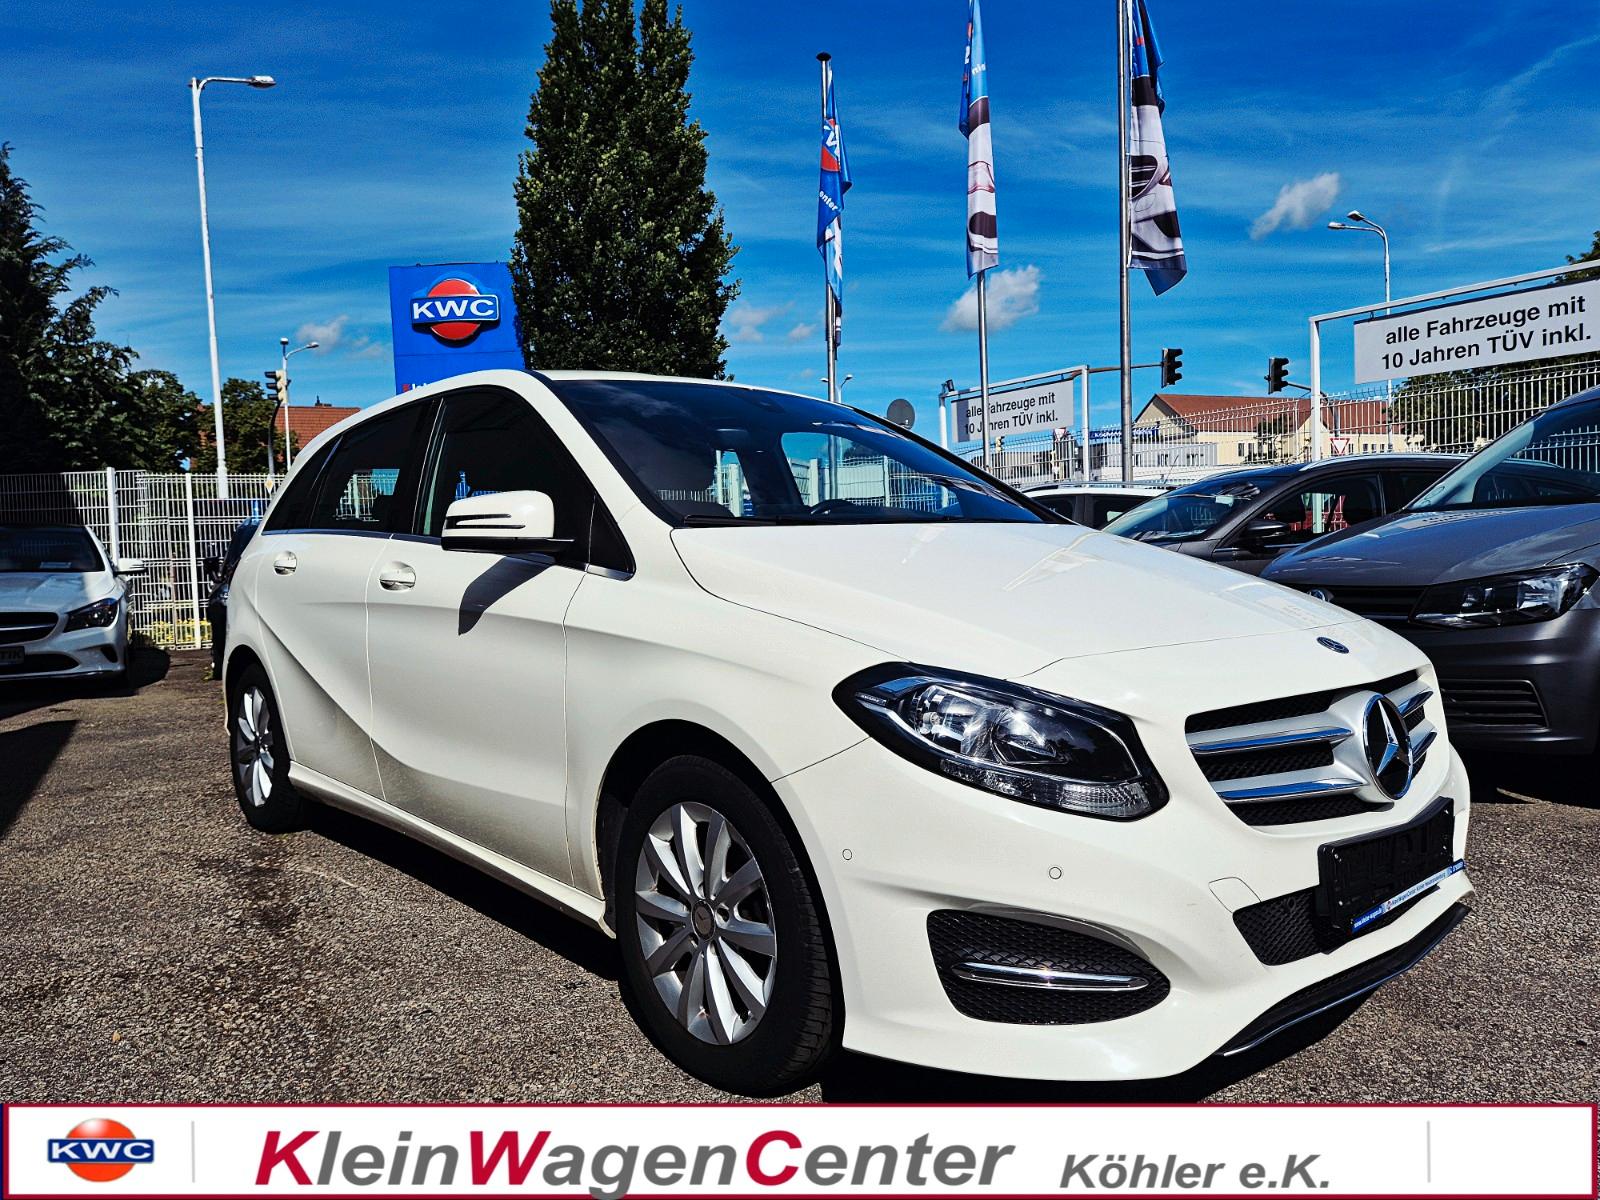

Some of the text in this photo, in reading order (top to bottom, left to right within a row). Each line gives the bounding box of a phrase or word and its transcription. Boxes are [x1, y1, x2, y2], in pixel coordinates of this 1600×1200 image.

[412, 299, 495, 320] KWC
[1386, 295, 1586, 345] alle Fahrzeuge mit
[1382, 323, 1591, 370] 10 Jahren TÜV inkl.
[966, 392, 1056, 418] alle ahrzeuge mit
[965, 423, 975, 434] 10
[1012, 412, 1034, 427] TÜV
[1036, 410, 1058, 424] inkl.
